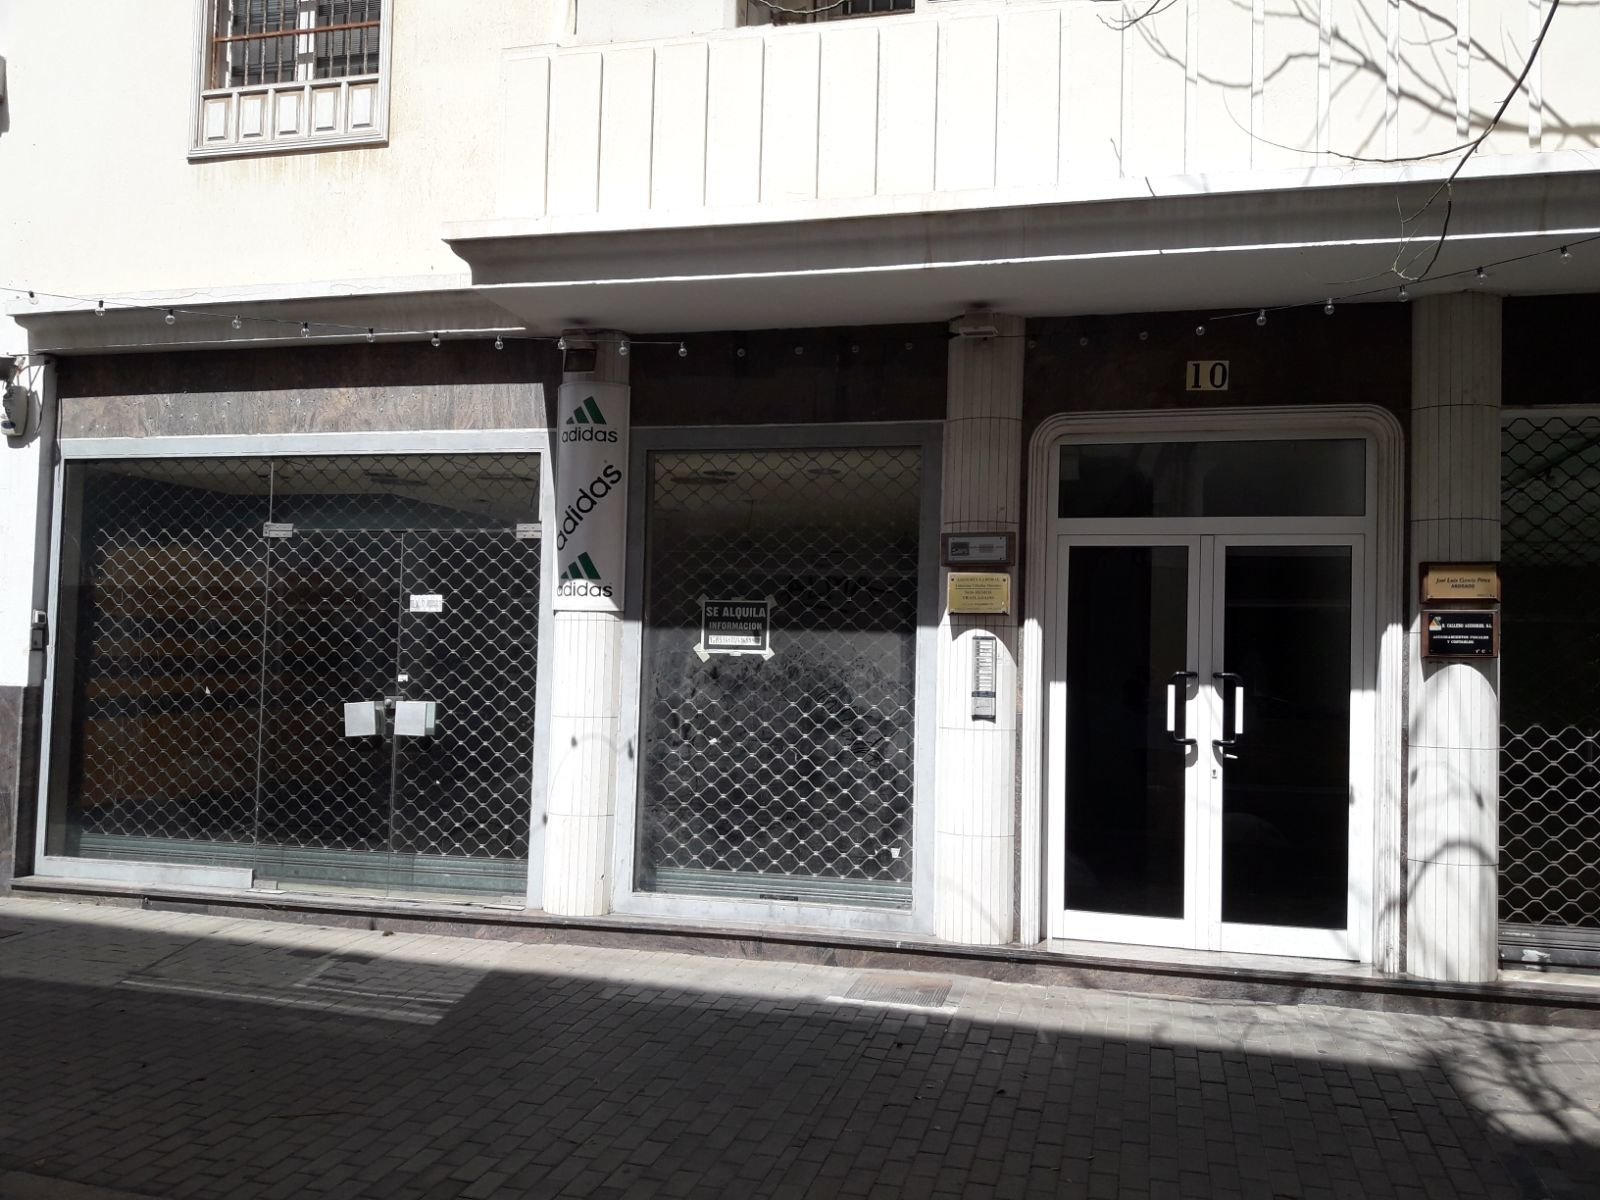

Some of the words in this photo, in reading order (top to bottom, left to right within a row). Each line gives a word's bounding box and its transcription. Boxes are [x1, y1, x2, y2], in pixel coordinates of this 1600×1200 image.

[1191, 362, 1227, 389] 10
[561, 426, 618, 443] adidas
[556, 464, 622, 551] adidas
[557, 582, 613, 598] adidas
[705, 606, 719, 617] SE
[722, 606, 766, 620] ALQUILA
